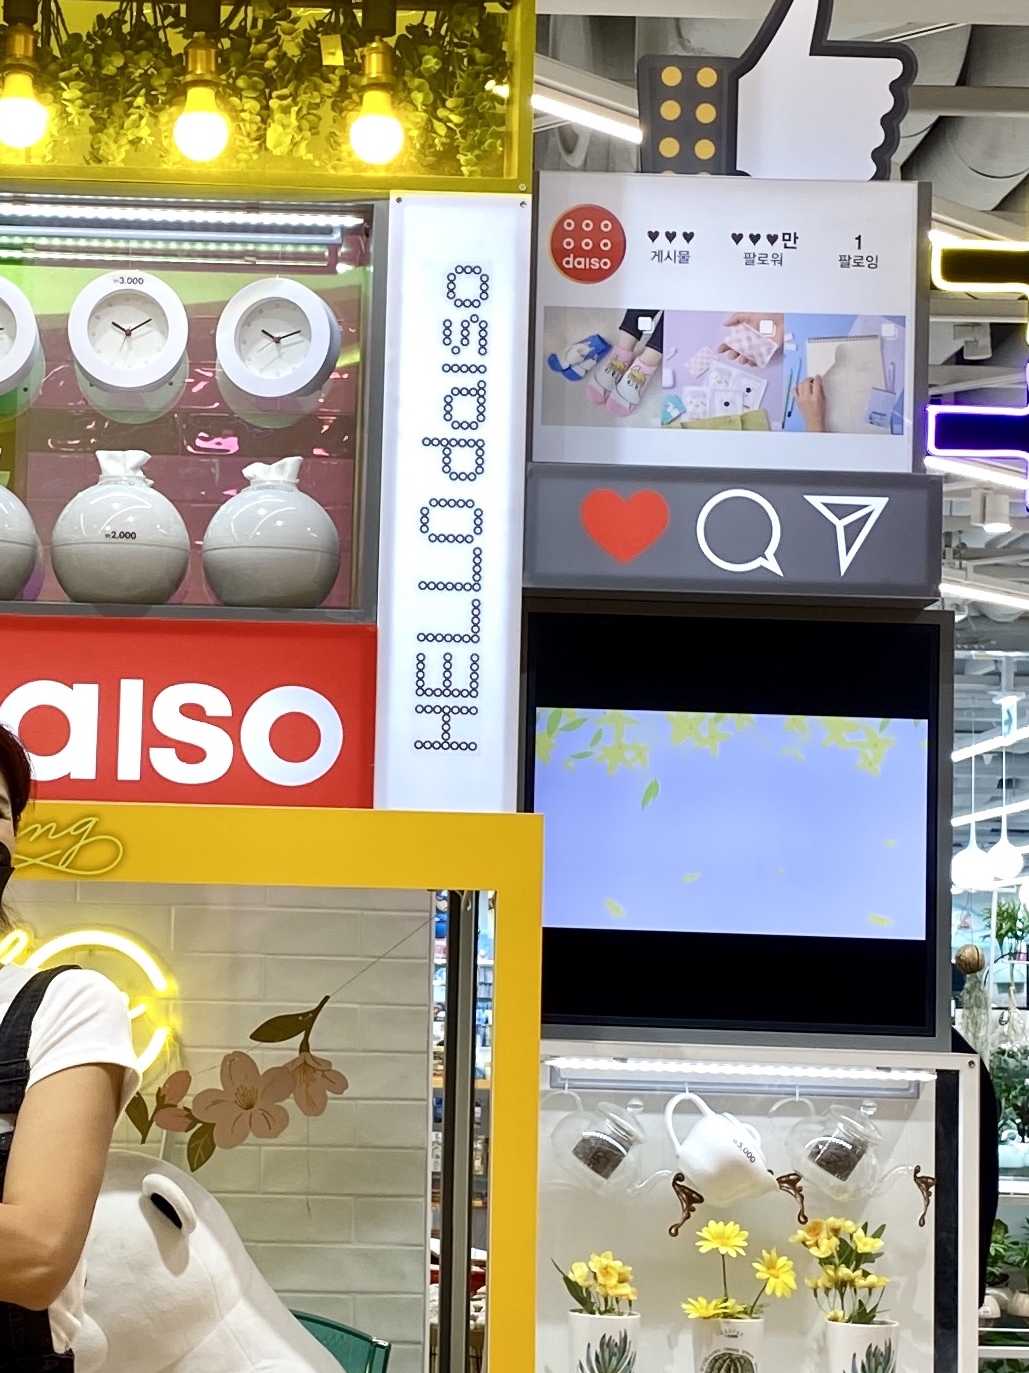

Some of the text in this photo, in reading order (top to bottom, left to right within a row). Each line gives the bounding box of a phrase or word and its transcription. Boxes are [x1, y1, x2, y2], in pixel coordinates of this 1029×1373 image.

[854, 234, 862, 250] 1
[562, 254, 611, 270] daiso
[650, 250, 691, 264] 게시물
[743, 252, 783, 266] 팔로워
[838, 254, 879, 269] 팔로잉
[413, 265, 489, 751] HELLO daiso
